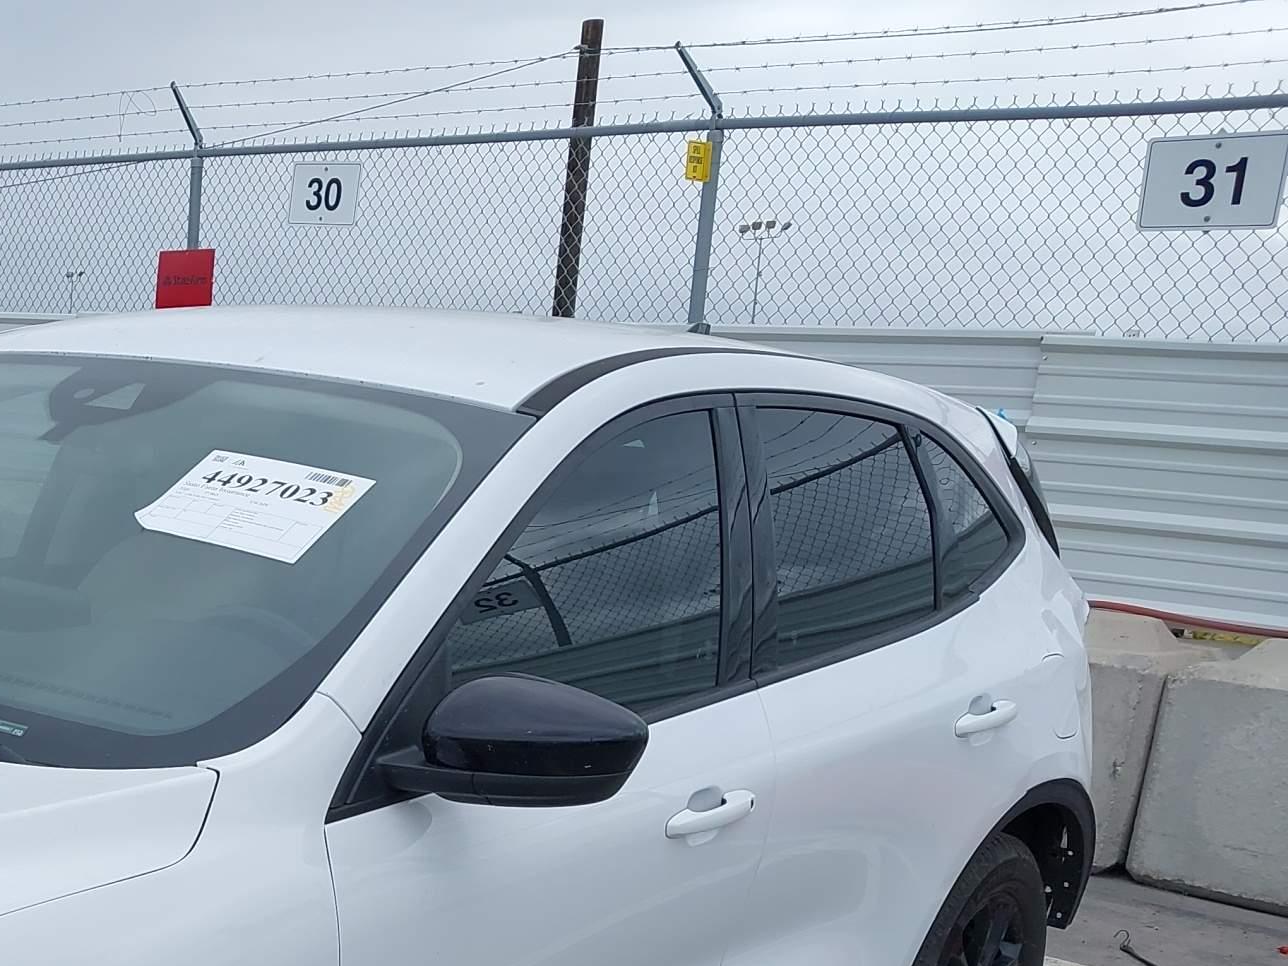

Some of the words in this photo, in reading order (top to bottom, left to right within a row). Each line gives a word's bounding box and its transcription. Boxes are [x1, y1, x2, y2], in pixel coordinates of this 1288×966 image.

[305, 177, 342, 211] 30
[1180, 156, 1249, 208] 31
[202, 470, 334, 507] 44927023
